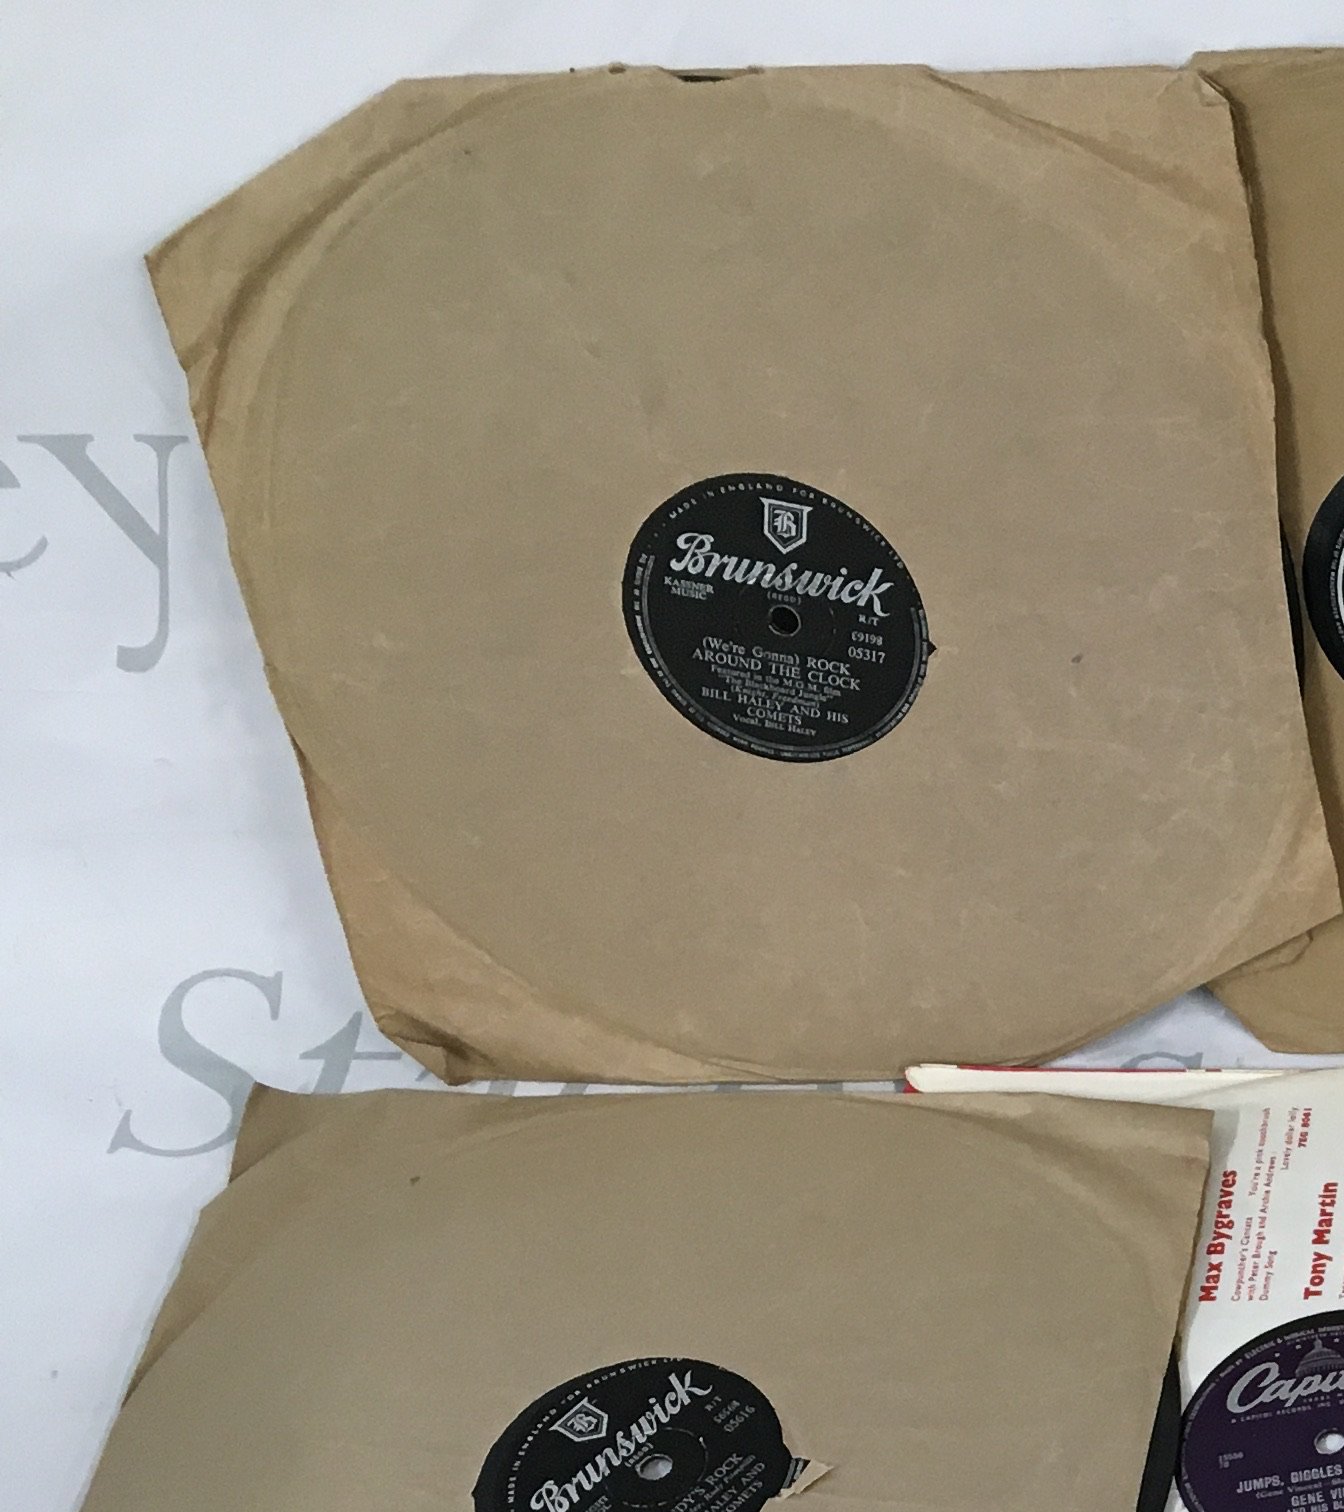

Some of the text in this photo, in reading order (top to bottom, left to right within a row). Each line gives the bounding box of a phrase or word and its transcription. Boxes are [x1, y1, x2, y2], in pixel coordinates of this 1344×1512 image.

[669, 532, 895, 618] Brunswick
[692, 648, 762, 672] AROUND
[769, 661, 802, 679] THE
[808, 670, 861, 691] CLOCK
[806, 656, 851, 676] ROCK
[848, 646, 886, 664] 05317
[701, 686, 732, 702] BILL
[737, 692, 786, 712] HALEY
[790, 702, 822, 719] AND
[826, 709, 849, 724] HIS
[746, 706, 802, 725] COMETS
[1199, 1169, 1238, 1303] Max Bygraves
[1303, 1182, 1339, 1300] Tony Martin
[723, 1404, 756, 1434] 05616
[704, 1452, 744, 1487] ROCK
[741, 1461, 767, 1490] AND
[1291, 1491, 1325, 1507] GENE
